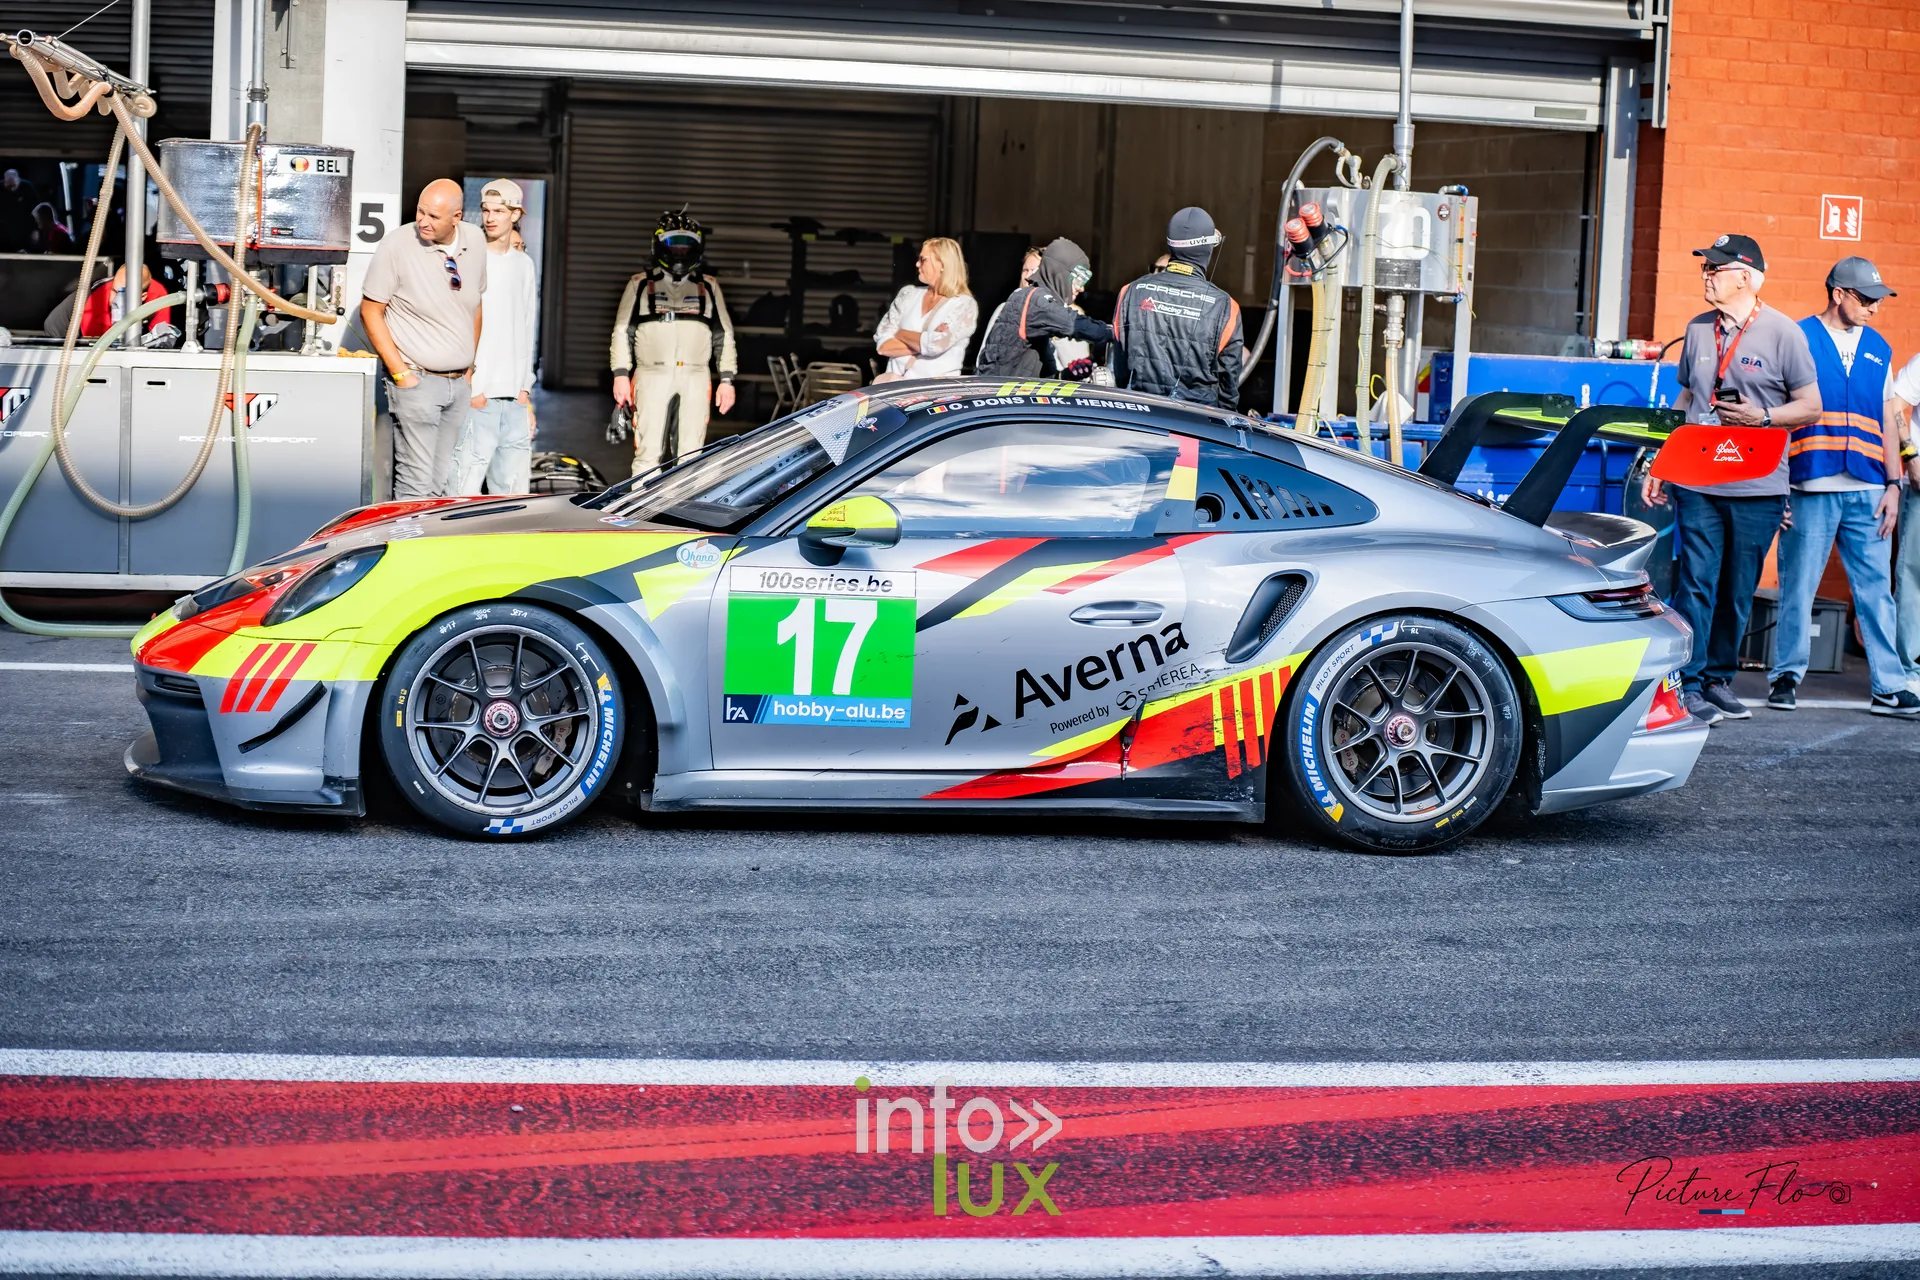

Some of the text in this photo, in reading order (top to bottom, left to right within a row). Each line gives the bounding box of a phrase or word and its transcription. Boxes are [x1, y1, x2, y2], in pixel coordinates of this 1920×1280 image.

[316, 159, 341, 173] BEL
[356, 202, 386, 244] 5
[1136, 283, 1217, 304] PORSCHE
[1157, 303, 1201, 318] Racing Team
[948, 402, 969, 411] O.
[973, 396, 1025, 408] DONS
[1052, 397, 1151, 413] K. HENSEN
[680, 546, 716, 565] Ohana
[758, 571, 894, 593] 100series.be
[776, 598, 879, 696] 17
[1015, 622, 1190, 720] Averna
[1315, 643, 1355, 692] PILOT SPORT
[773, 700, 906, 722] hobby-alu.be
[1050, 703, 1110, 734] Powered by
[584, 706, 615, 790] MICHELIN
[1300, 702, 1326, 792] MICHELIN
[530, 795, 579, 826] PILOT SPORT
